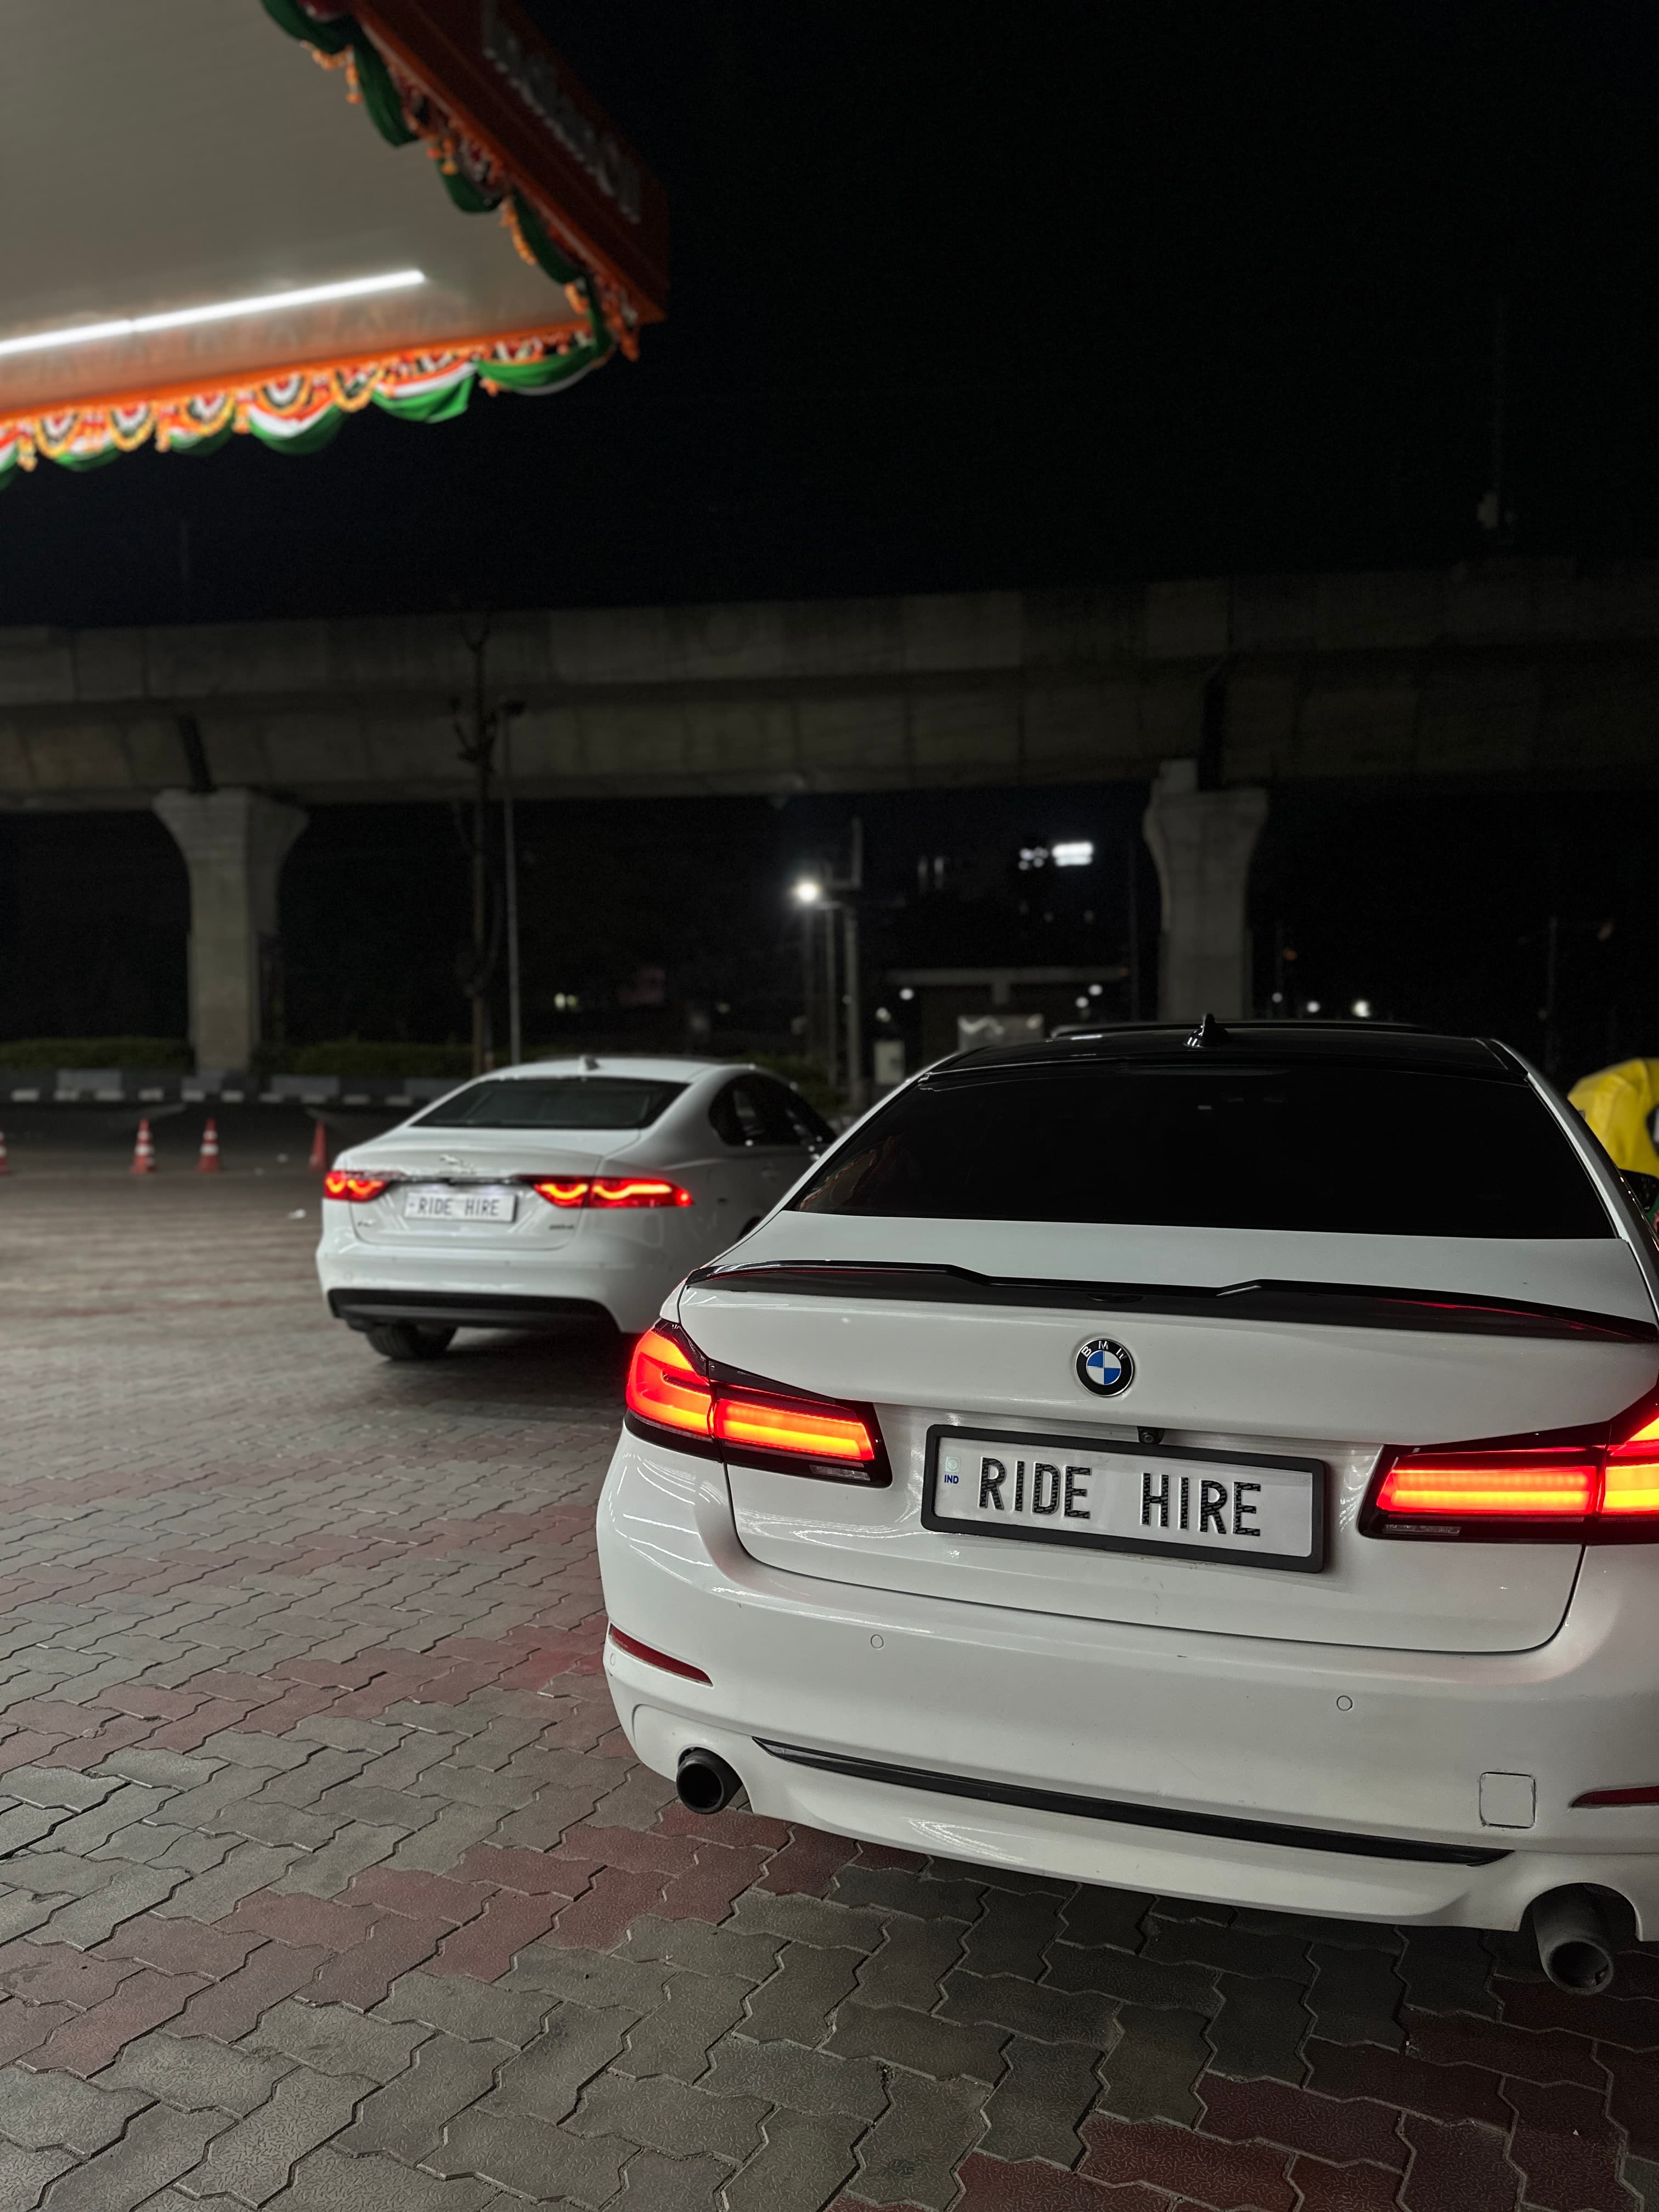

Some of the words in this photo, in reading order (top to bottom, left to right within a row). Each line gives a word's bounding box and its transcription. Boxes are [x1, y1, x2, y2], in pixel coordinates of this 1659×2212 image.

[417, 1197, 453, 1215] RIDE
[465, 1198, 499, 1216] HIRE
[1081, 1340, 1128, 1360] BMW
[944, 1474, 959, 1484] IND
[978, 1457, 1091, 1519] RIDE
[1141, 1472, 1261, 1536] HIRE
